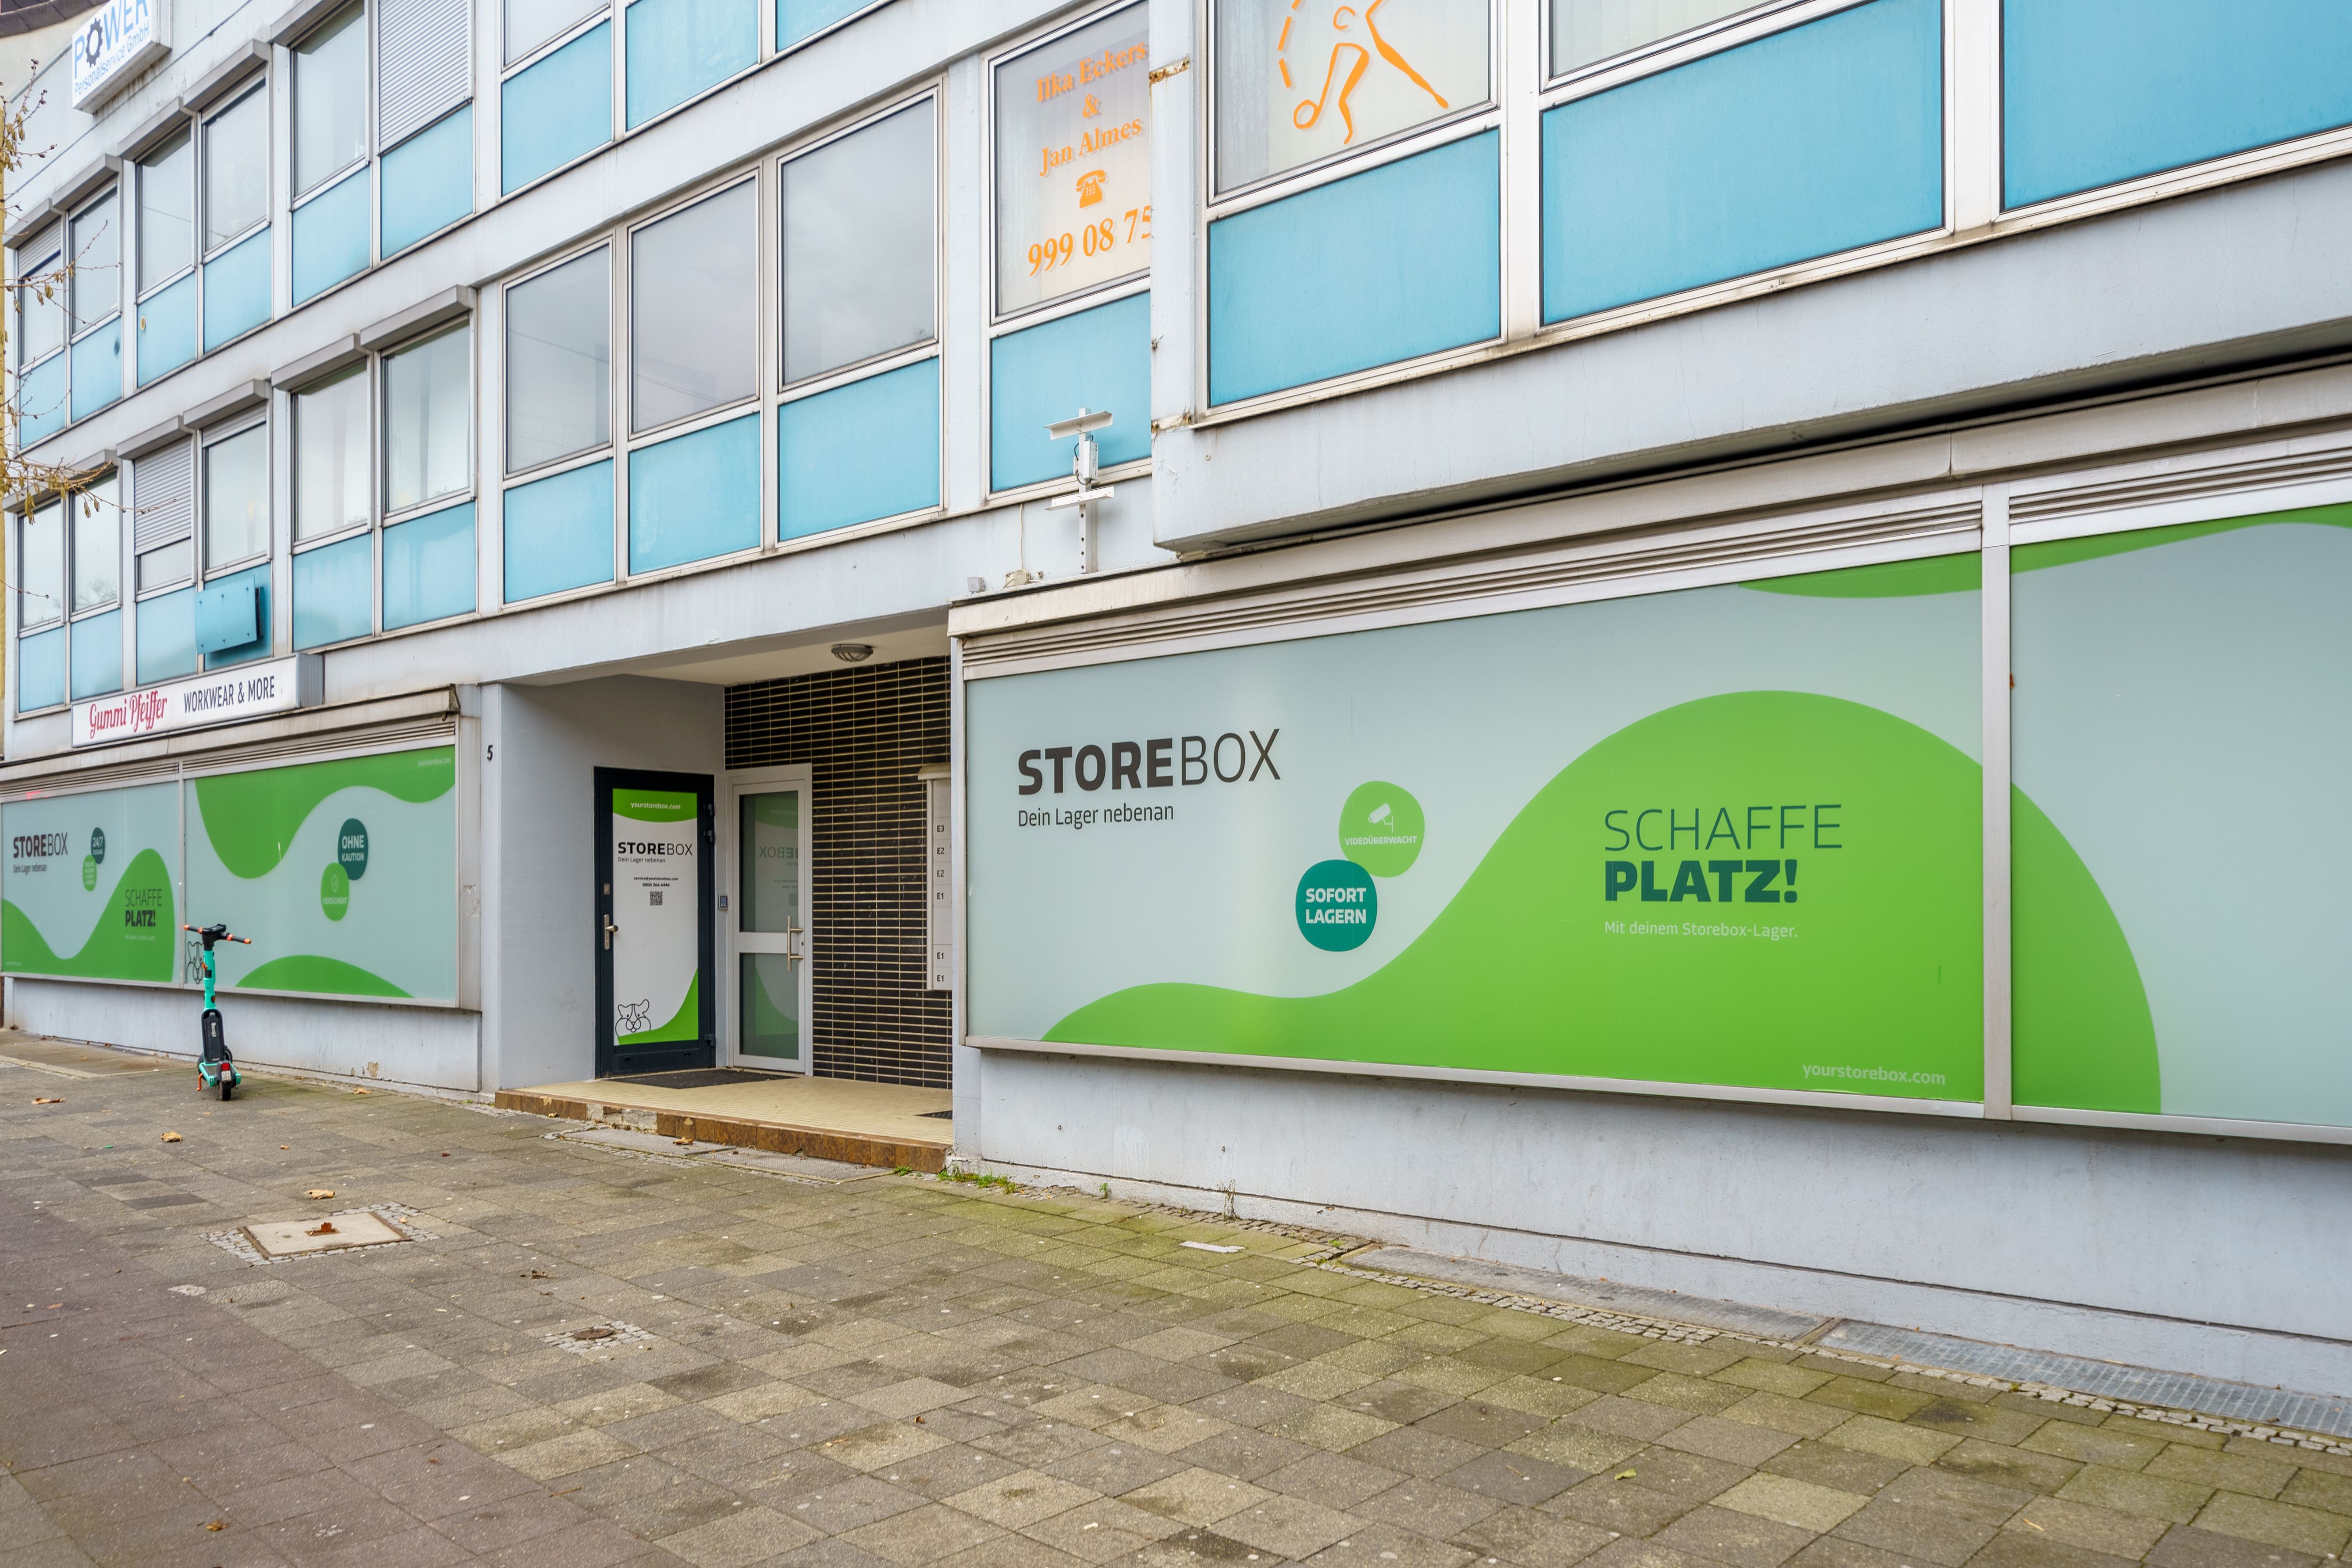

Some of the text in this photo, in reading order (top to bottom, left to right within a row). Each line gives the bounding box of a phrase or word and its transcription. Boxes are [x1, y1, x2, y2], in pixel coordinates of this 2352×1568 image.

[75, 20, 149, 99] Personalservice GmbH
[1035, 72, 1073, 102] Ilka
[1082, 93, 1100, 118] &
[1039, 118, 1142, 176] Jan Almes
[1028, 232, 1073, 276] 999
[1083, 218, 1114, 257] 08
[183, 676, 275, 713] WORKWEAR & MORE
[90, 690, 167, 739] Gummi Pfeiffer
[486, 745, 493, 761] 5
[1018, 728, 1282, 796] STOREBOX
[631, 801, 681, 811] yourstorebox.com
[1018, 803, 1174, 829] Dein Lager nebenan
[1344, 834, 1417, 845] VIDEOÜBERWACHT
[1604, 804, 1842, 852] SCHAFFE
[13, 832, 68, 858] STOREBOX
[342, 835, 364, 849] OHNE
[618, 842, 693, 856] STOREBOX
[342, 852, 364, 861] KAUTION
[1605, 859, 1798, 904] PLATZ!
[125, 889, 163, 907] SCHAFFE
[1305, 888, 1367, 904] SOFORT
[125, 910, 156, 927] PLATZ!
[1305, 909, 1367, 925] LAGERN
[1604, 920, 1798, 941] Mit deinem Storebox-Lager.
[1803, 1064, 1946, 1086] yourstorebox.com
